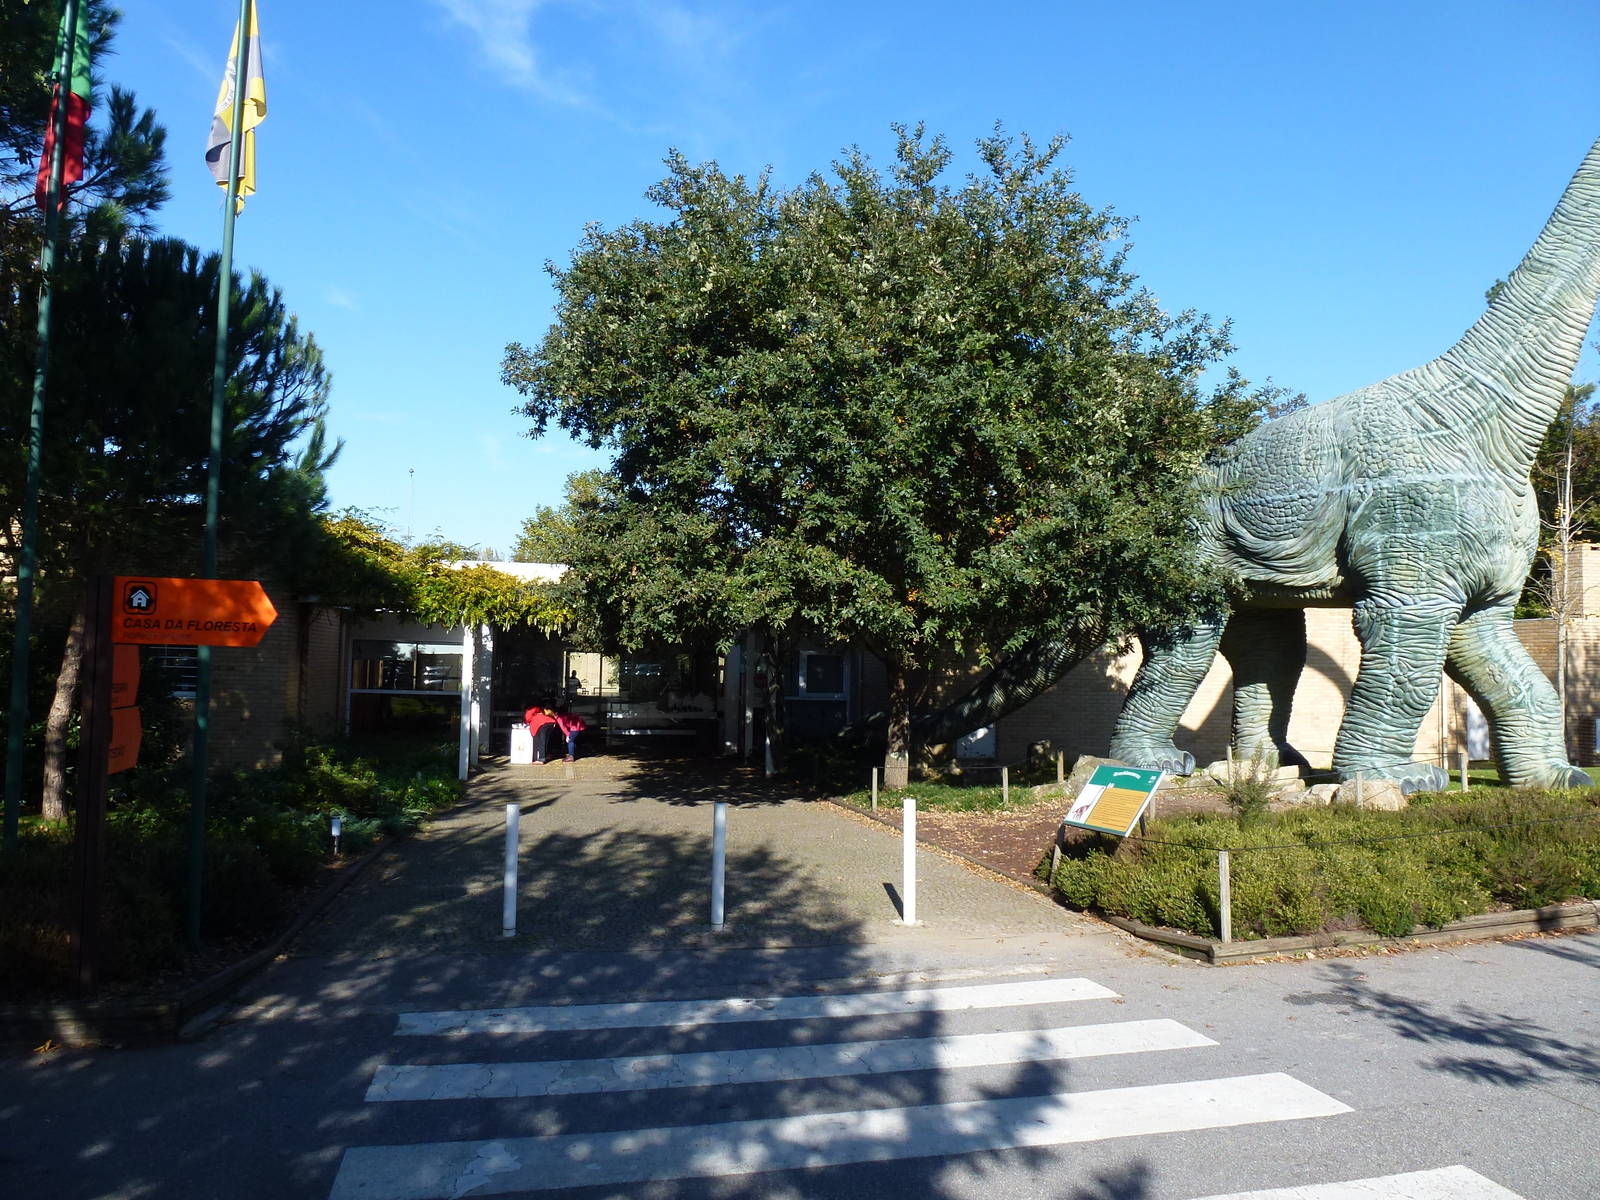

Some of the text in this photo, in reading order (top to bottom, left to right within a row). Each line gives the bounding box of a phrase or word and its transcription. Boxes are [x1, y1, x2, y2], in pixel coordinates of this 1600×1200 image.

[123, 617, 257, 633] CASA DA FLORESTA
